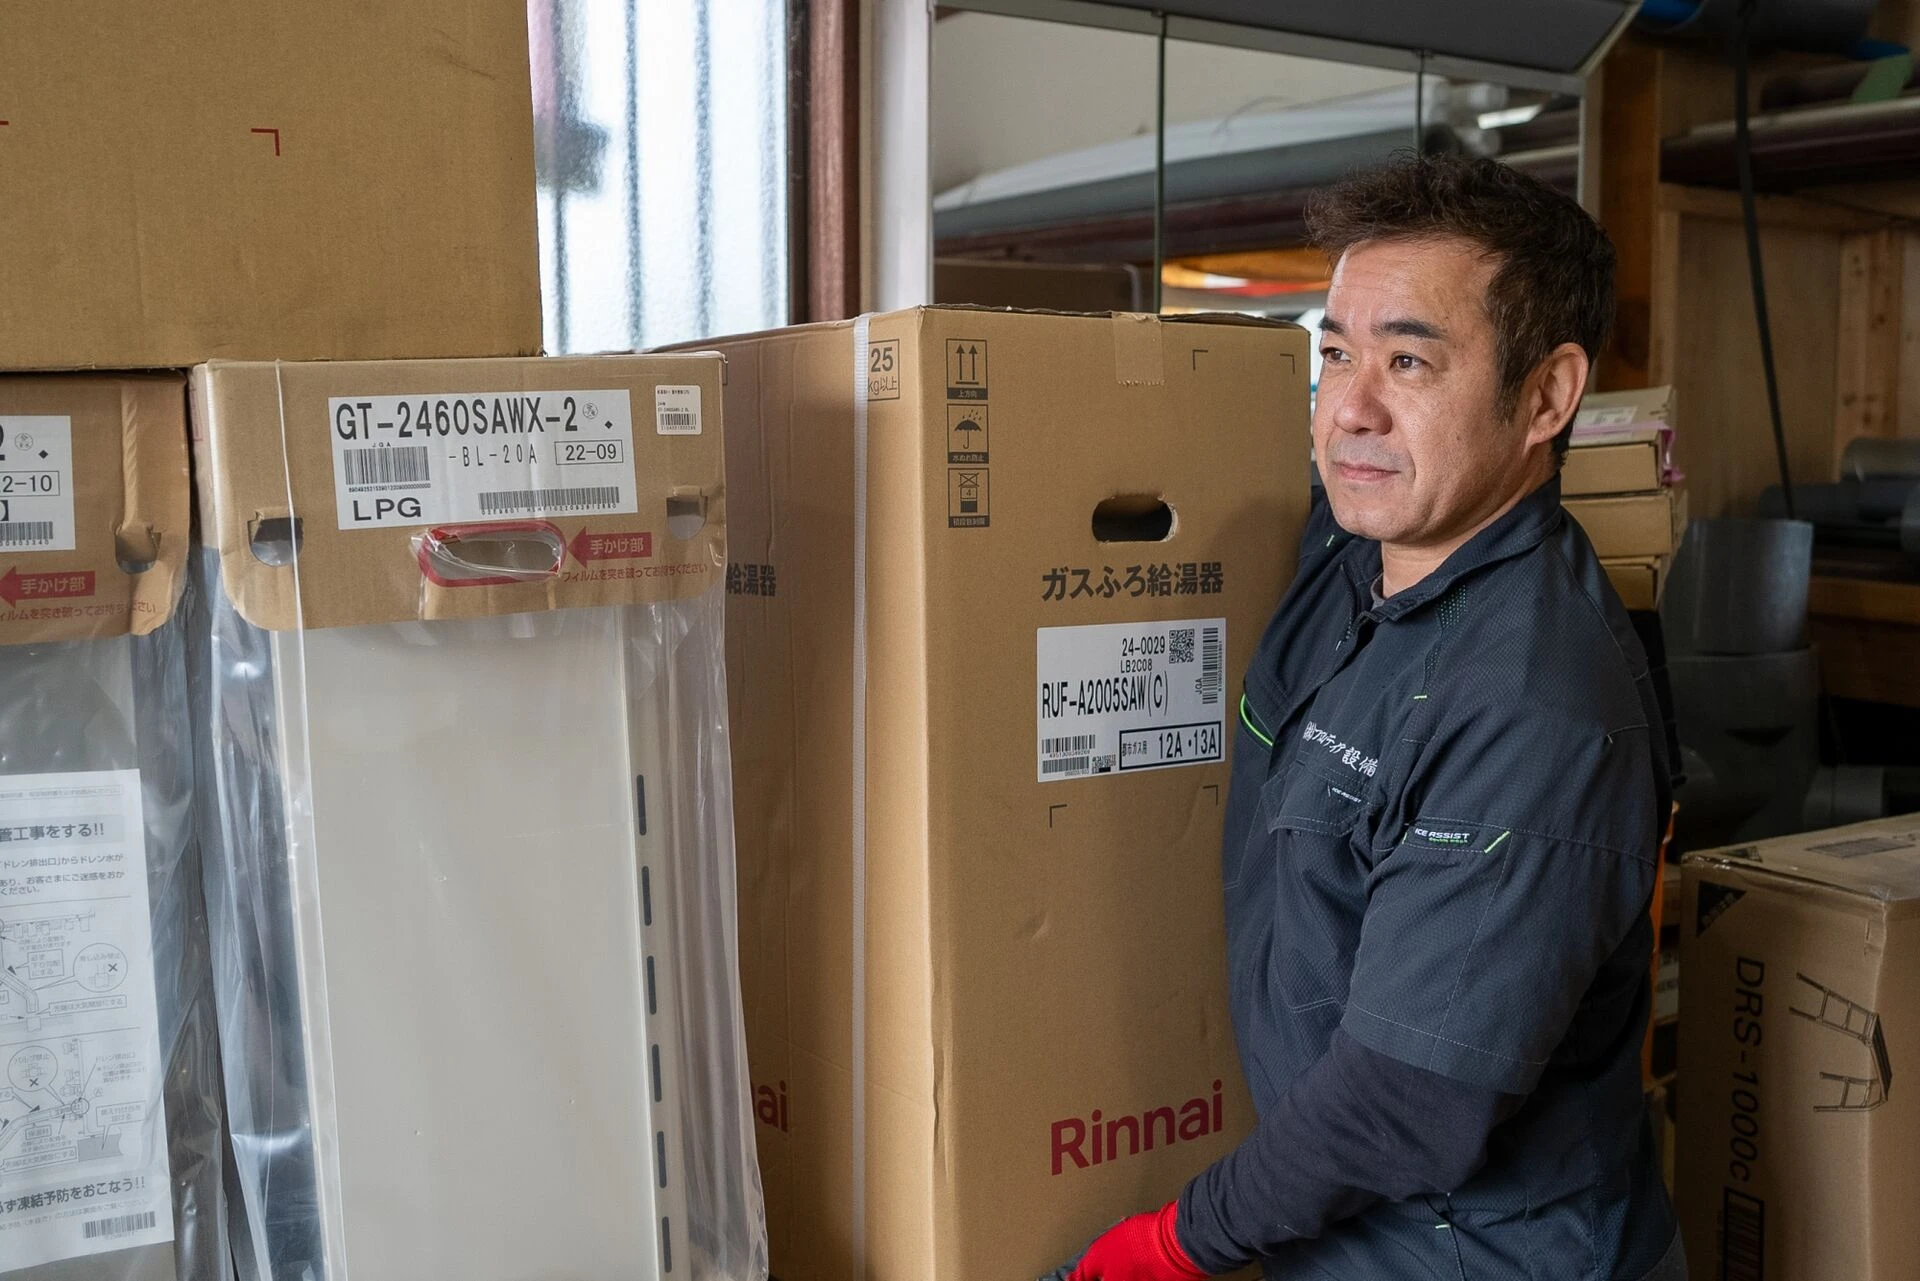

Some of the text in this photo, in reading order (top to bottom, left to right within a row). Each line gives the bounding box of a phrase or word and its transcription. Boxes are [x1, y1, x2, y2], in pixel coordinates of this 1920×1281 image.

[871, 347, 894, 373] 25
[336, 396, 578, 440] GT-2460SAWX-2
[565, 444, 617, 461] 22-09
[0, 475, 52, 493] 2-10
[353, 497, 422, 521] LPG
[590, 537, 645, 555] 手かけ部
[21, 575, 86, 595] 手かけ部
[1042, 562, 1224, 601] ガスふろ給湯器
[1121, 635, 1166, 657] 24-0029
[1042, 671, 1169, 719] RUF-A2005SAW(C)
[1415, 828, 1470, 840] ICE ASSIST
[1729, 955, 1766, 1182] DRS-1000c
[1051, 1079, 1223, 1176] Rinnai
[0, 1176, 145, 1214] ず凍結予防をおこなう!!
